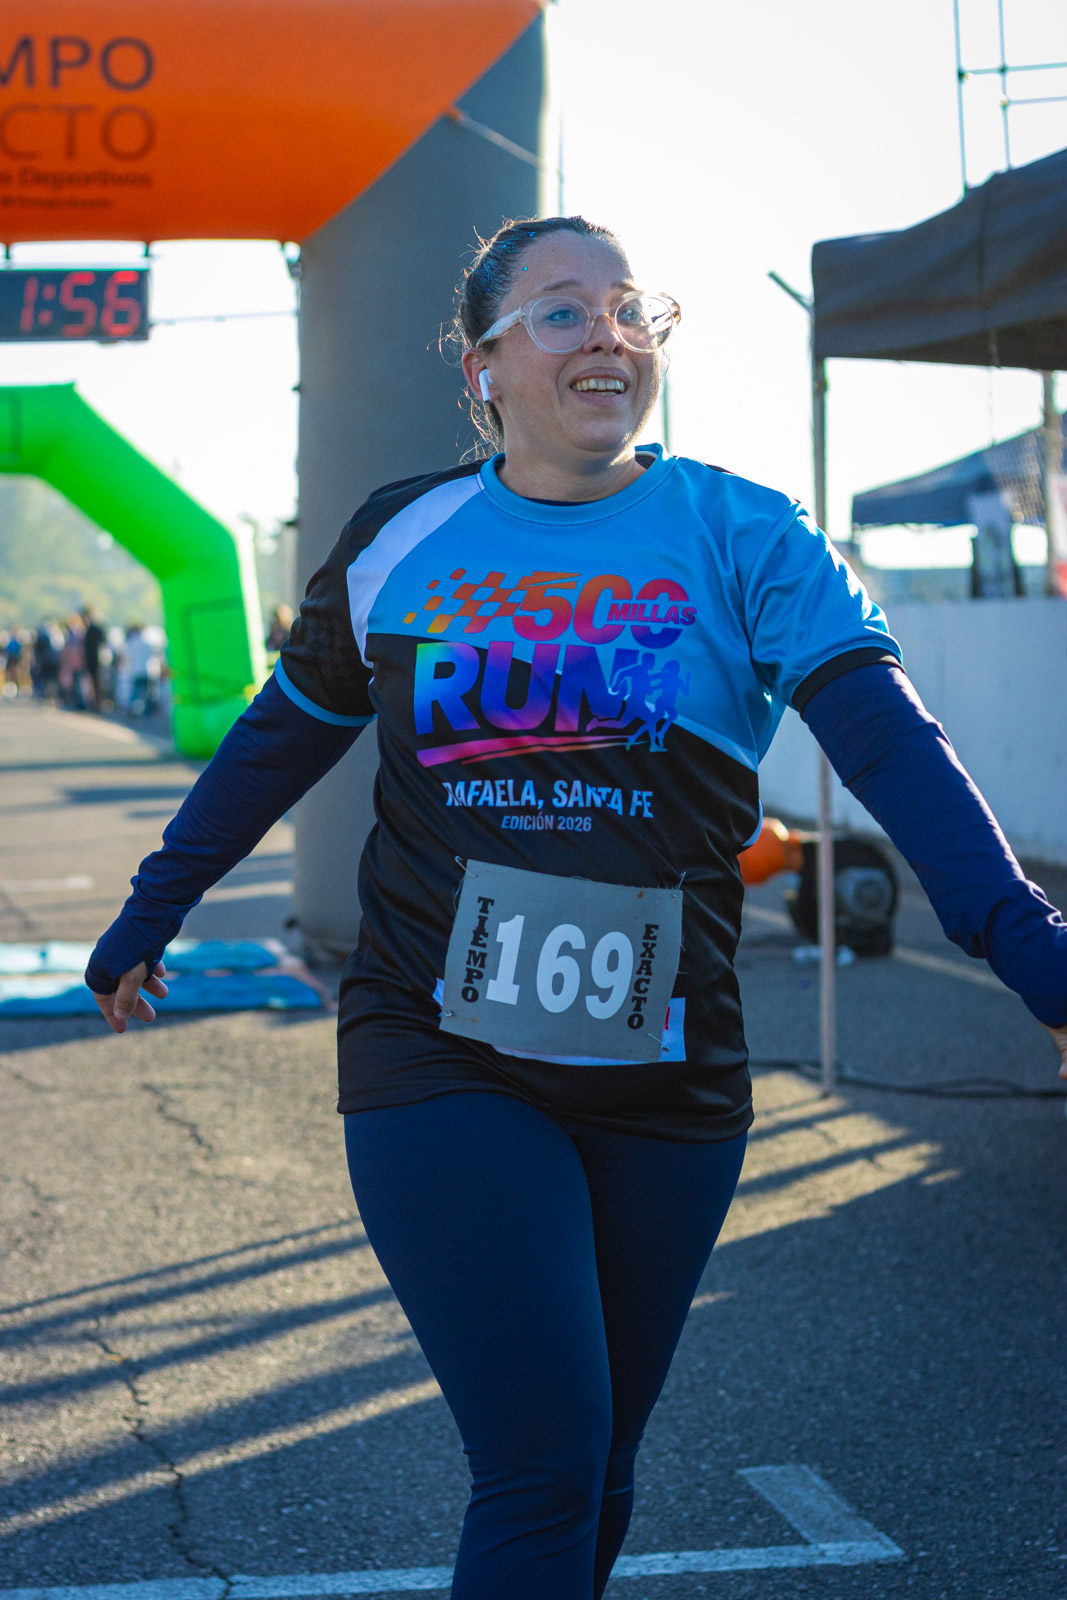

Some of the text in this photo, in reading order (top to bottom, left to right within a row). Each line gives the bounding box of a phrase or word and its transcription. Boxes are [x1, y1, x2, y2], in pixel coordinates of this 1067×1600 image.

[0, 103, 156, 162] CTO
[20, 270, 141, 338] 1:56
[512, 570, 698, 649] 500 MILLAS
[413, 641, 640, 736] RUN
[501, 811, 592, 832] EDICIÓN 2026
[552, 780, 623, 816] SANTA
[629, 789, 654, 818] FE
[461, 896, 495, 1003] TIEMPO
[485, 914, 634, 1020] 169
[627, 923, 659, 1030] EXACTO
